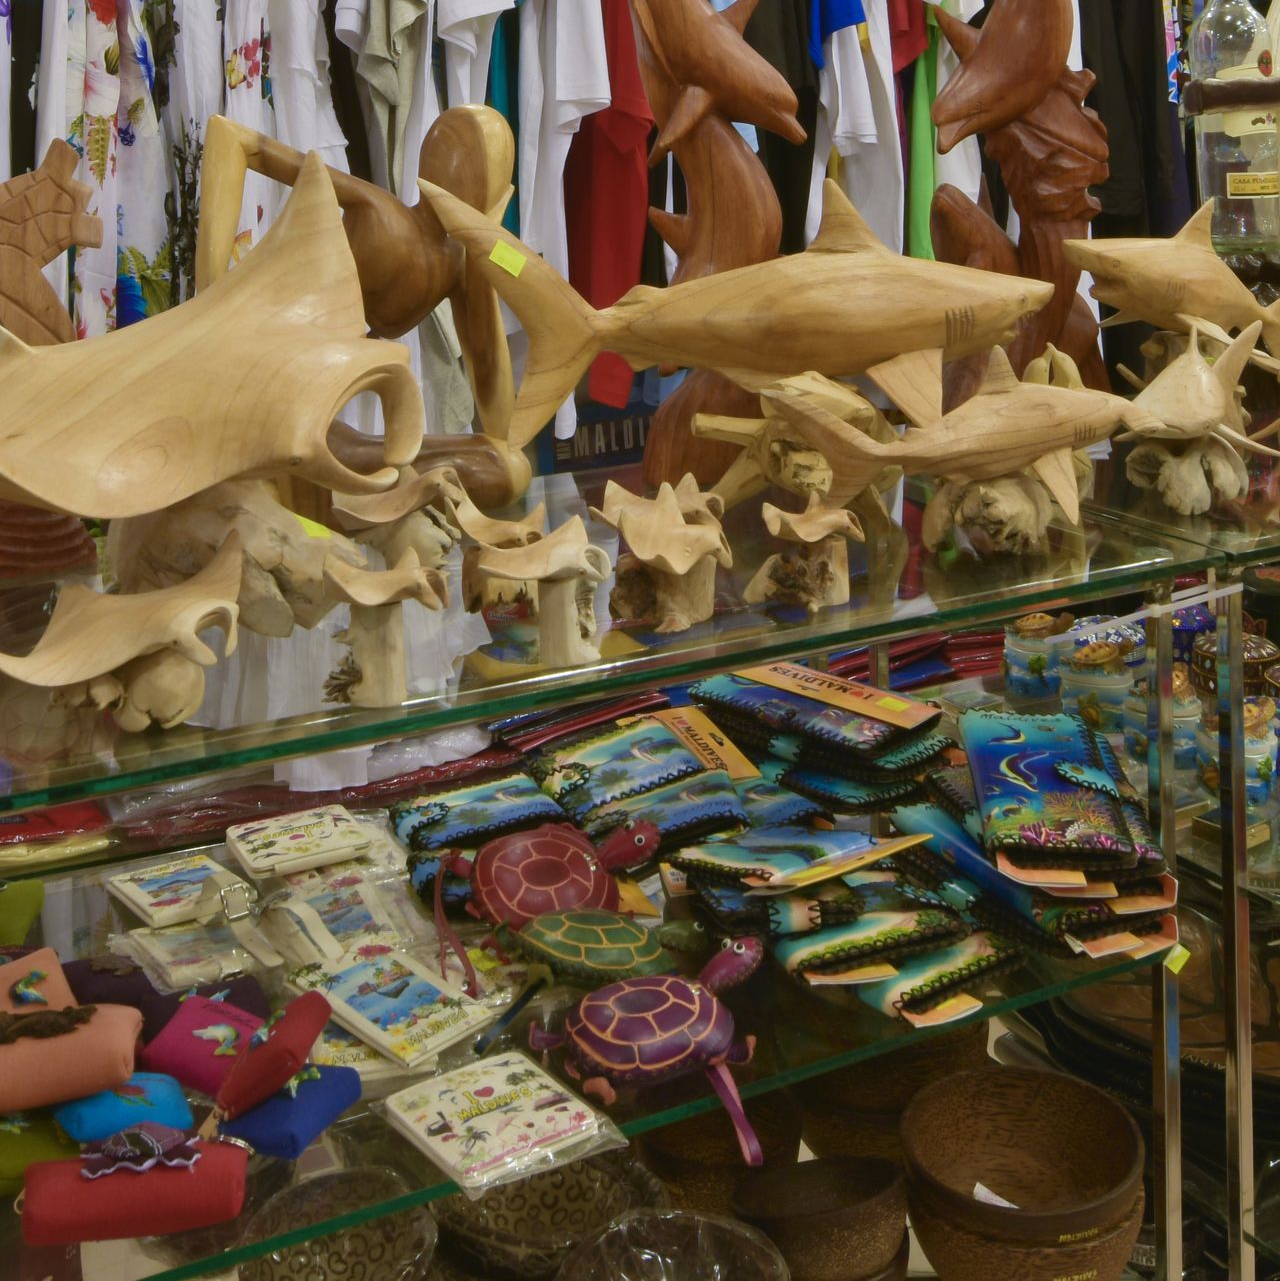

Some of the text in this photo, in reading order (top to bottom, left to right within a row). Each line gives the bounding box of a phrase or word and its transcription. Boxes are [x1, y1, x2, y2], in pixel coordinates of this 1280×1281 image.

[573, 418, 645, 458] MALDI
[770, 665, 851, 694] MALDIVES
[685, 724, 729, 772] MALDIVES
[405, 1007, 470, 1047] MALDIVES
[457, 1085, 533, 1121] MALDIVES
[463, 1090, 478, 1105] I
